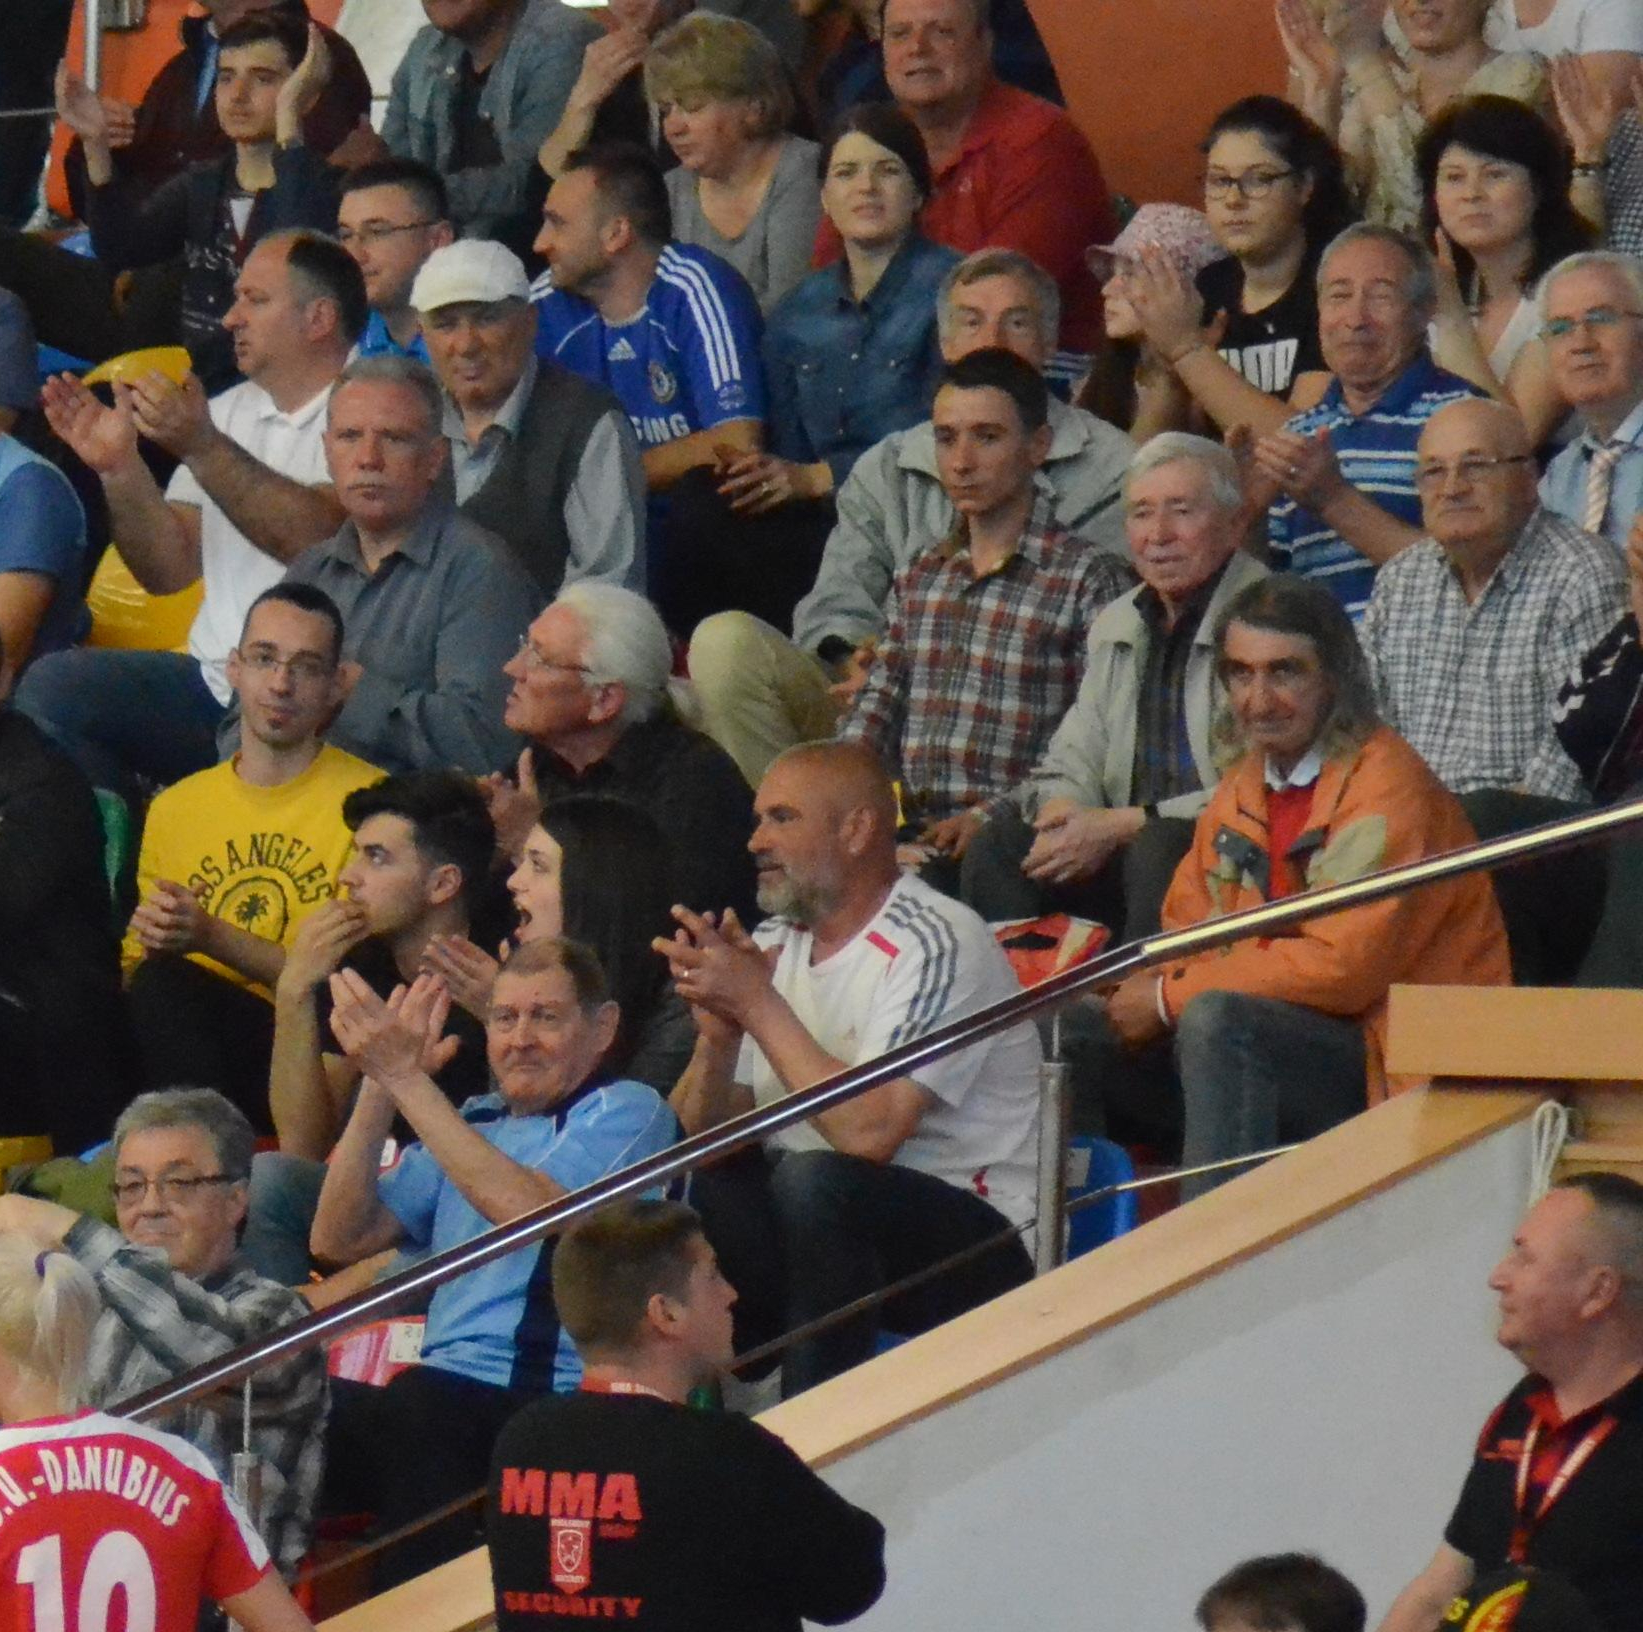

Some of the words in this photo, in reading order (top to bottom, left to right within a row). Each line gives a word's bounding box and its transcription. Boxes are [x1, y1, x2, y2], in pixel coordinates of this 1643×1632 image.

[188, 856, 224, 912] OS
[226, 832, 334, 905] ANGELES
[500, 1466, 643, 1521] MMA
[501, 1590, 644, 1618] SECURITY
